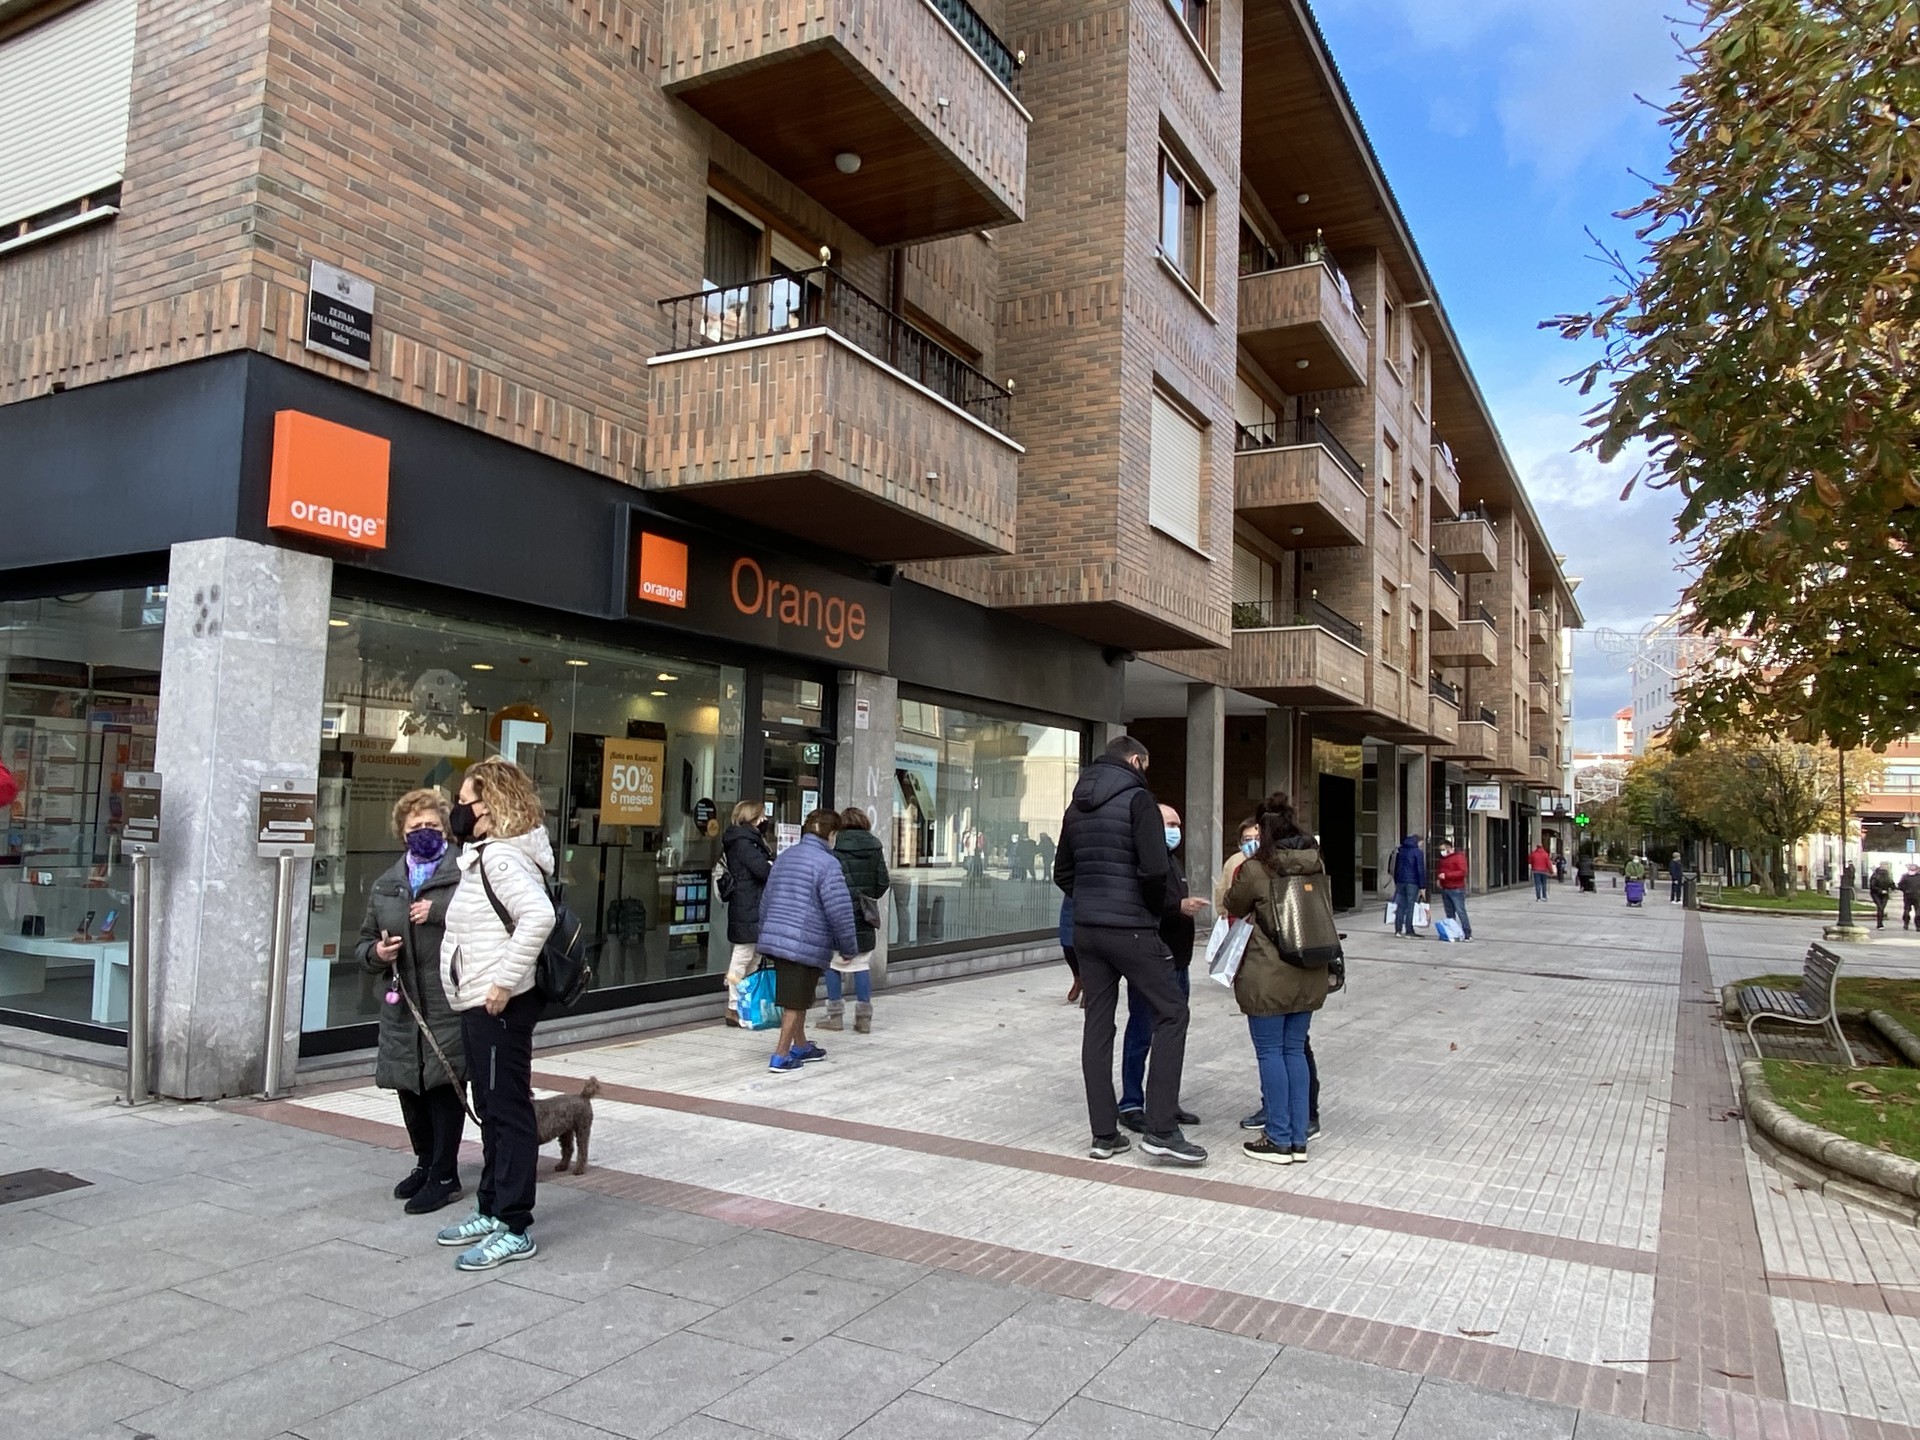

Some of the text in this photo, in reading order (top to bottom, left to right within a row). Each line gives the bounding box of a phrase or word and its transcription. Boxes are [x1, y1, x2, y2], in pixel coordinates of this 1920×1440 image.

[291, 500, 377, 538] orange
[643, 581, 683, 602] orange
[731, 557, 866, 649] Orange
[360, 754, 421, 766] sostenible
[610, 791, 654, 805] 6 meses
